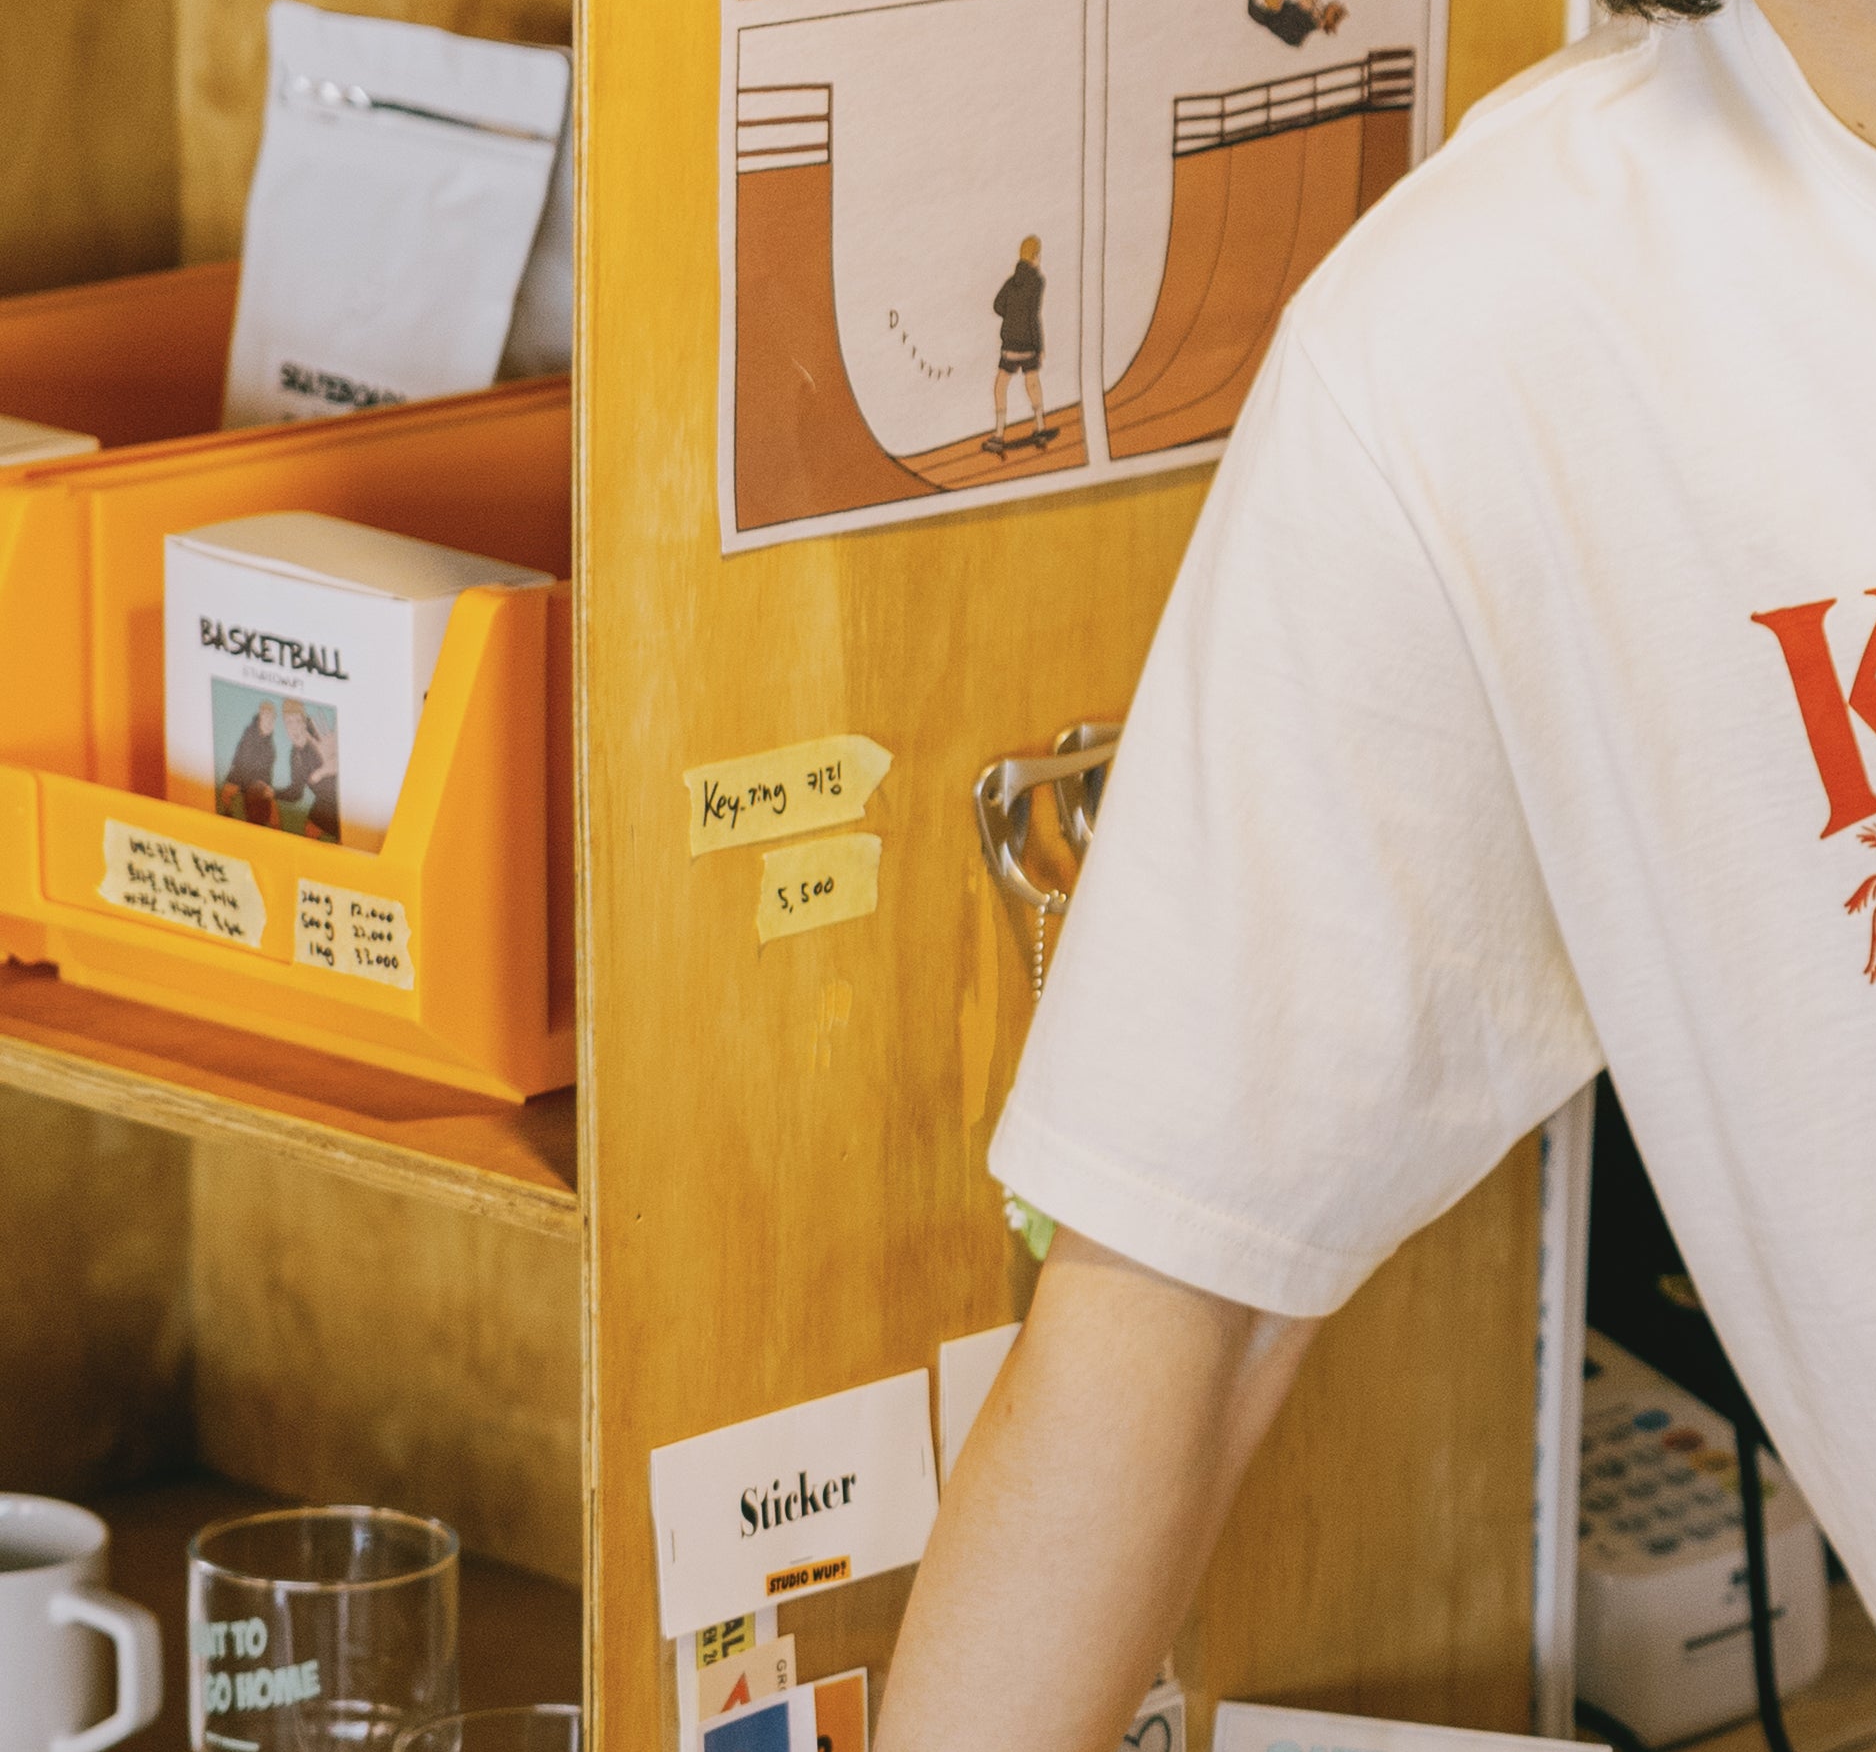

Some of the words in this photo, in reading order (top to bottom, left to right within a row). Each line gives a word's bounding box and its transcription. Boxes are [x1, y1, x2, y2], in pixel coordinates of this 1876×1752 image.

[199, 615, 349, 680] BASKETBALL
[807, 762, 842, 797] 키링
[740, 1471, 857, 1539] Sticker
[769, 1571, 809, 1594] STUDIO
[812, 1559, 848, 1583] WUP?
[231, 1616, 269, 1660] TO
[235, 1658, 322, 1712] HOME
